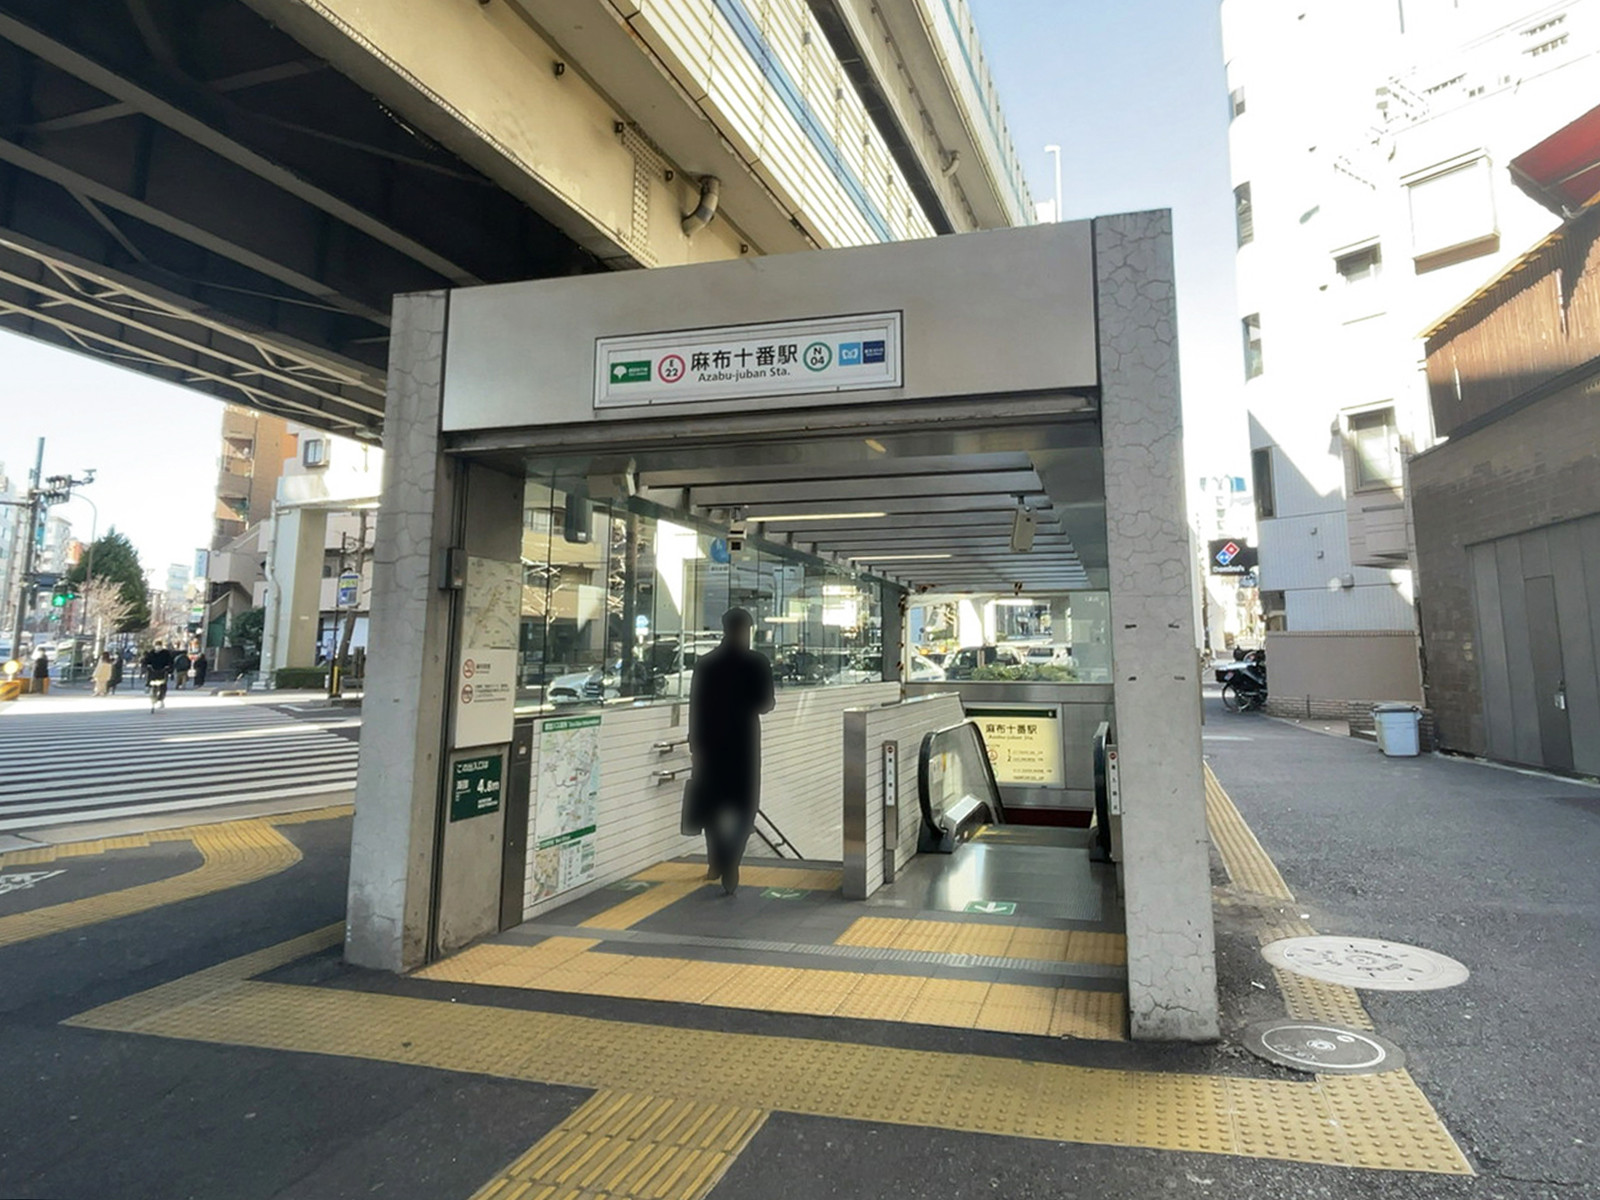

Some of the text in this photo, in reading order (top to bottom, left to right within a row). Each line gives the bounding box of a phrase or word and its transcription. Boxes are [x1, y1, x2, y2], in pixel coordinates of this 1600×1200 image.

[813, 347, 822, 355] N
[690, 344, 798, 371] 麻布十番駅
[810, 356, 825, 366] 04
[669, 359, 675, 367] E
[664, 368, 679, 377] 22
[698, 367, 791, 383] Azabu-juban Sta.
[986, 724, 1037, 734] 麻布十番駅
